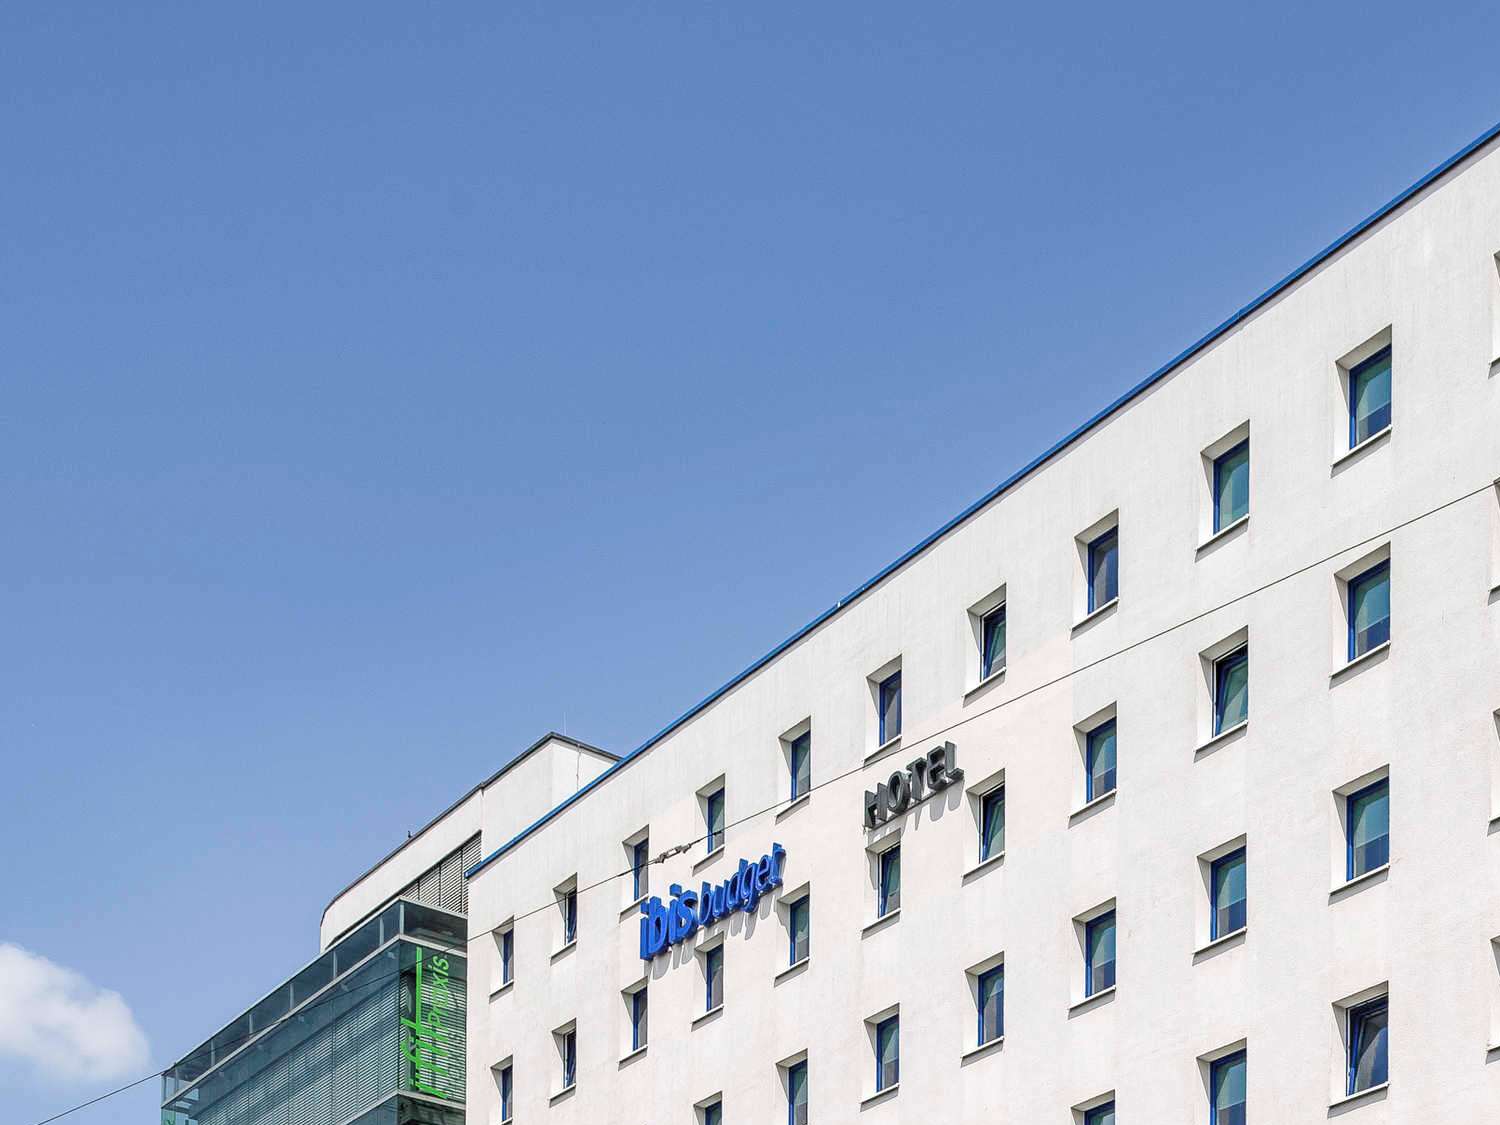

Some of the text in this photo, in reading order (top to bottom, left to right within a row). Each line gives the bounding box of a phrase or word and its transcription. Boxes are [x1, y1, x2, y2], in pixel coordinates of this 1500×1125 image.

[864, 740, 964, 829] HOTEL
[640, 843, 785, 960] ibis budget
